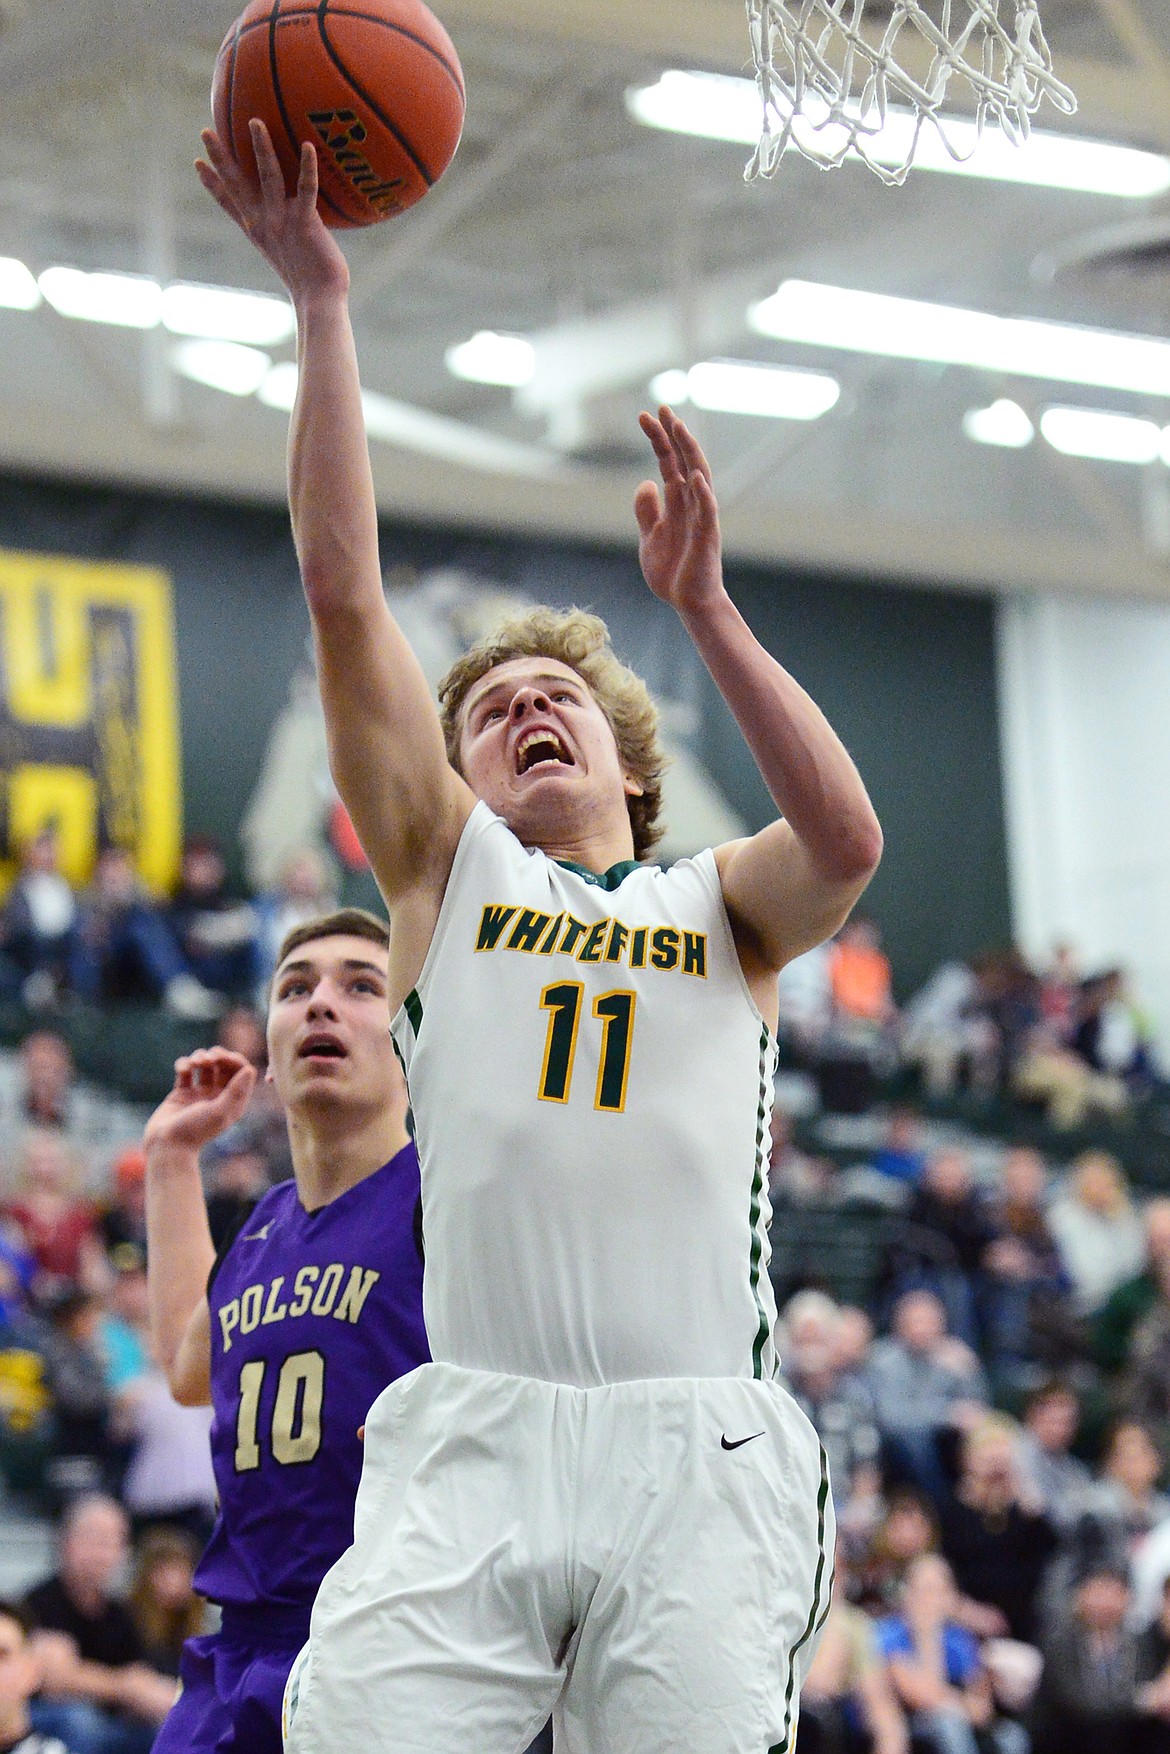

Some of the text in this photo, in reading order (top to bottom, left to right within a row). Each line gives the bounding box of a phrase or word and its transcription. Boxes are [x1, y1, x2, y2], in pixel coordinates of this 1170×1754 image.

[474, 903, 708, 980] WHITEFISH
[537, 980, 637, 1114] 11
[218, 1263, 380, 1353] POLSON
[234, 1350, 325, 1473] 10
